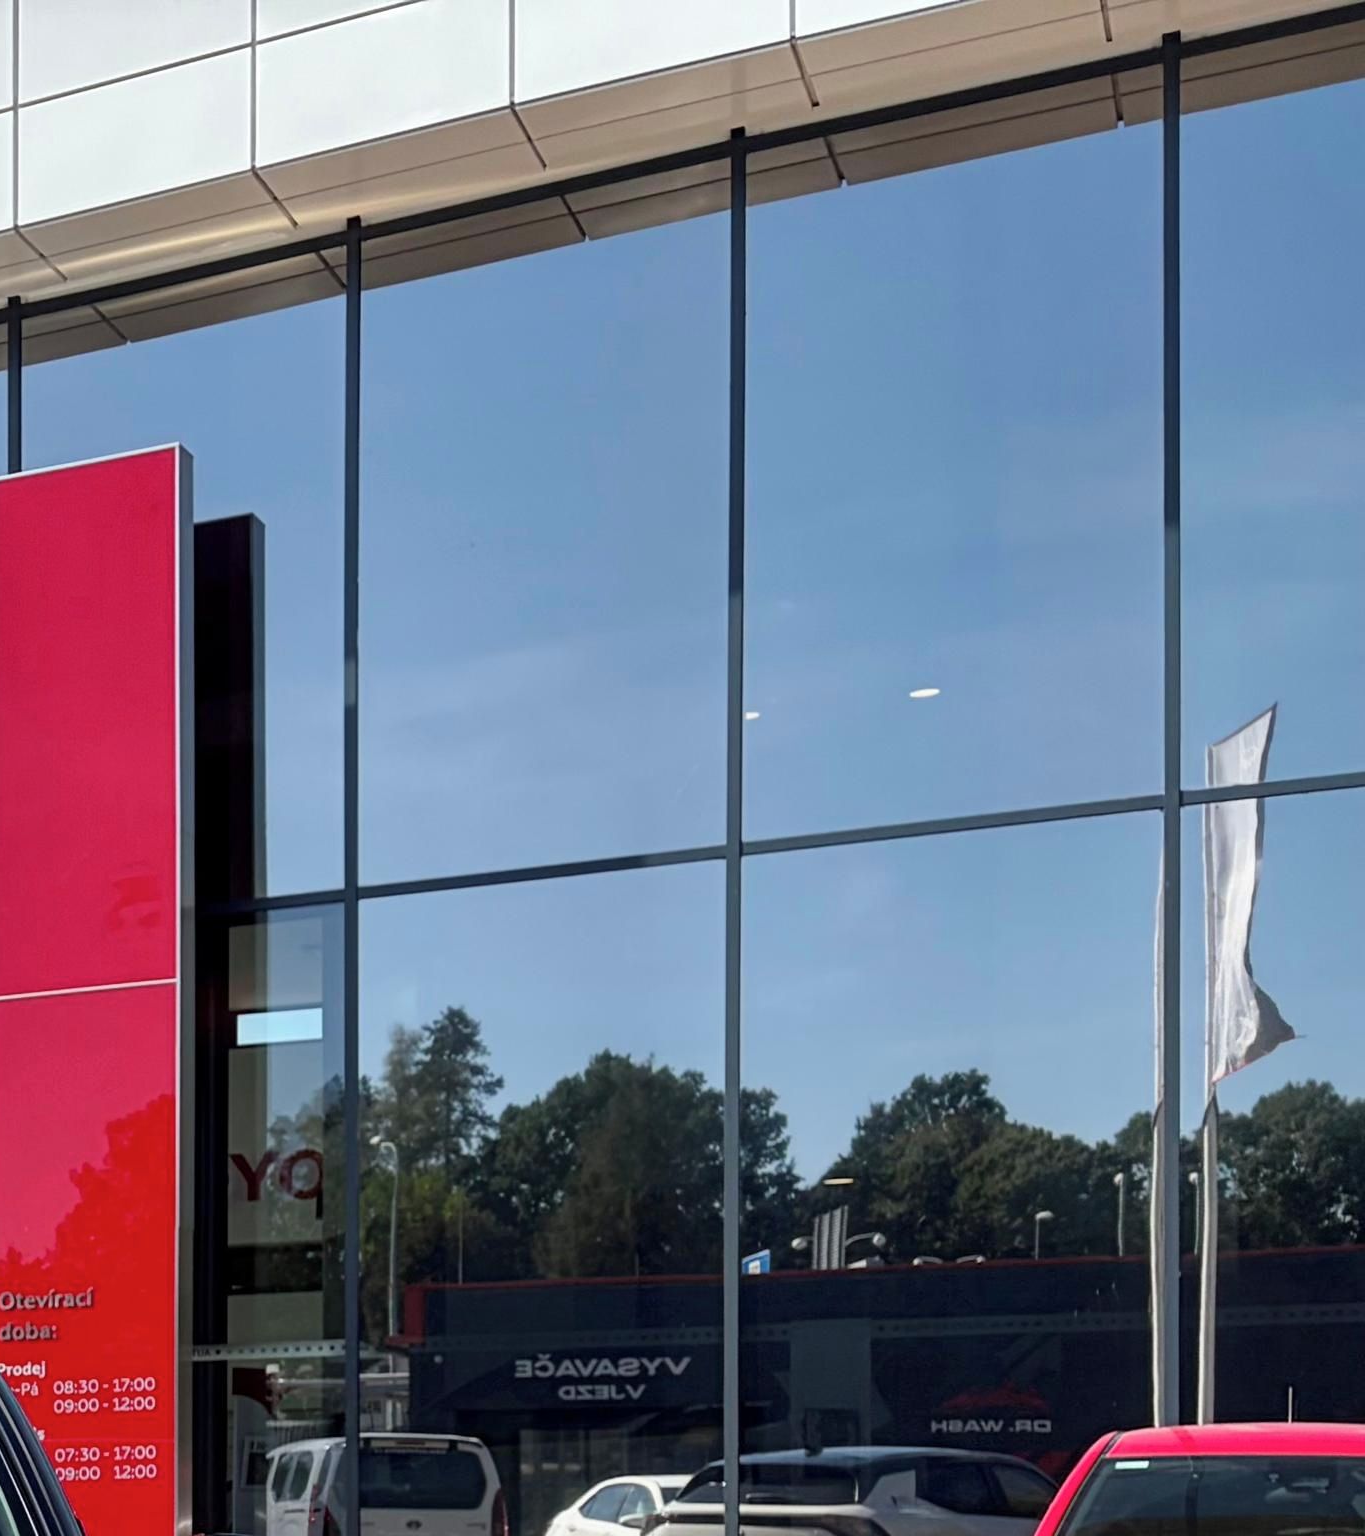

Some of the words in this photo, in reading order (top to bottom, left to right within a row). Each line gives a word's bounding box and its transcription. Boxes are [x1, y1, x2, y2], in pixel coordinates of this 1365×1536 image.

[53, 1379, 99, 1395] 08:30
[112, 1376, 156, 1393] 17:00
[54, 1398, 100, 1414] 09:00
[113, 1396, 156, 1412] 12:00
[54, 1447, 100, 1462] 07:30
[113, 1445, 157, 1460] 17:00
[55, 1467, 101, 1481] 09:00
[113, 1464, 157, 1480] 12:00
